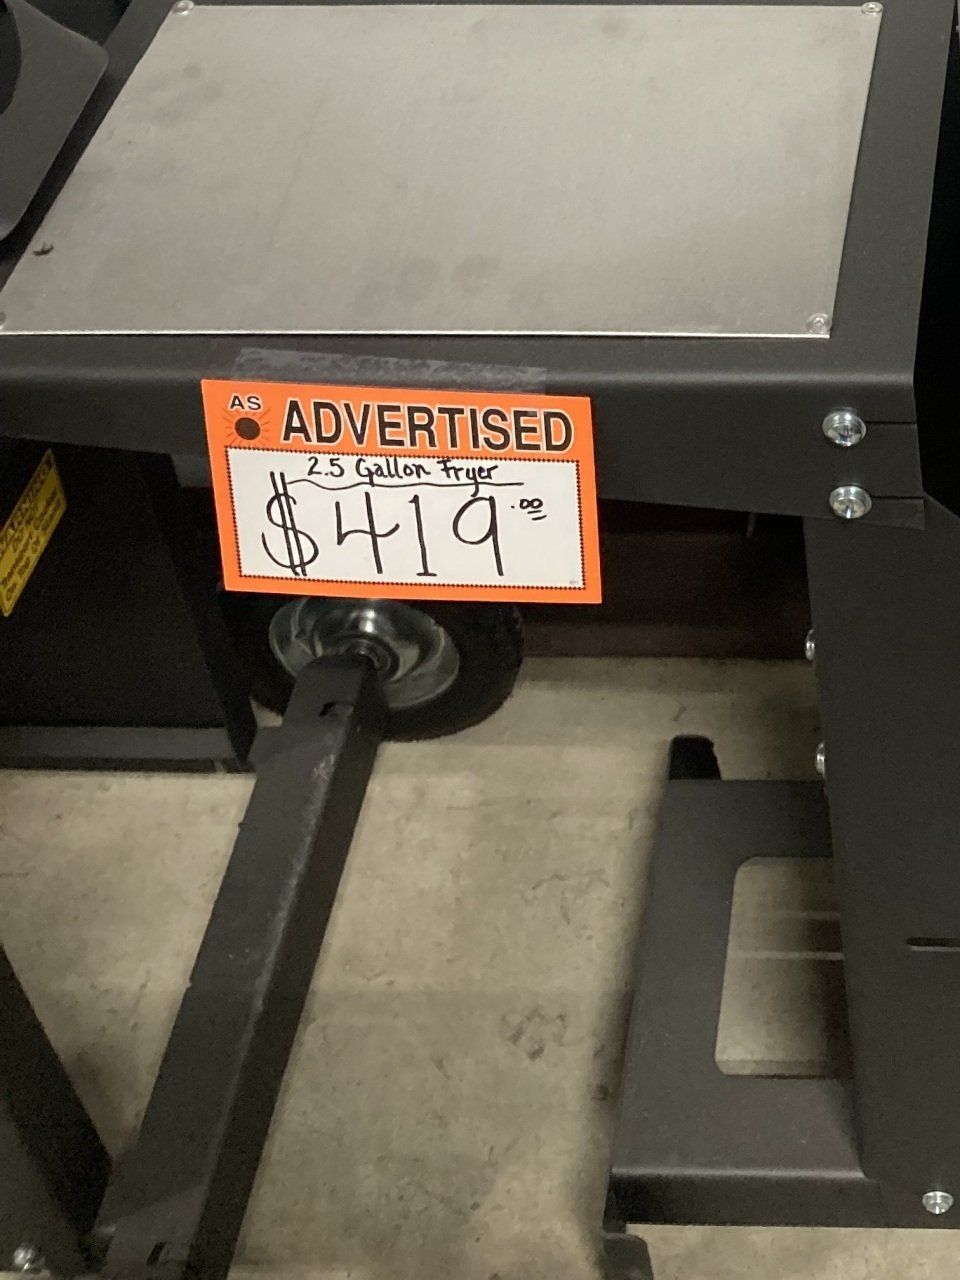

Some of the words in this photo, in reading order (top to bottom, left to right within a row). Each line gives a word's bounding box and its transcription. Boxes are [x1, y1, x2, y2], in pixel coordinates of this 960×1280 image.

[228, 393, 262, 411] AS
[282, 398, 574, 453] ADVERTISED
[306, 455, 345, 478] 2.5
[355, 457, 431, 487] Gallon
[436, 458, 499, 498] Fryer
